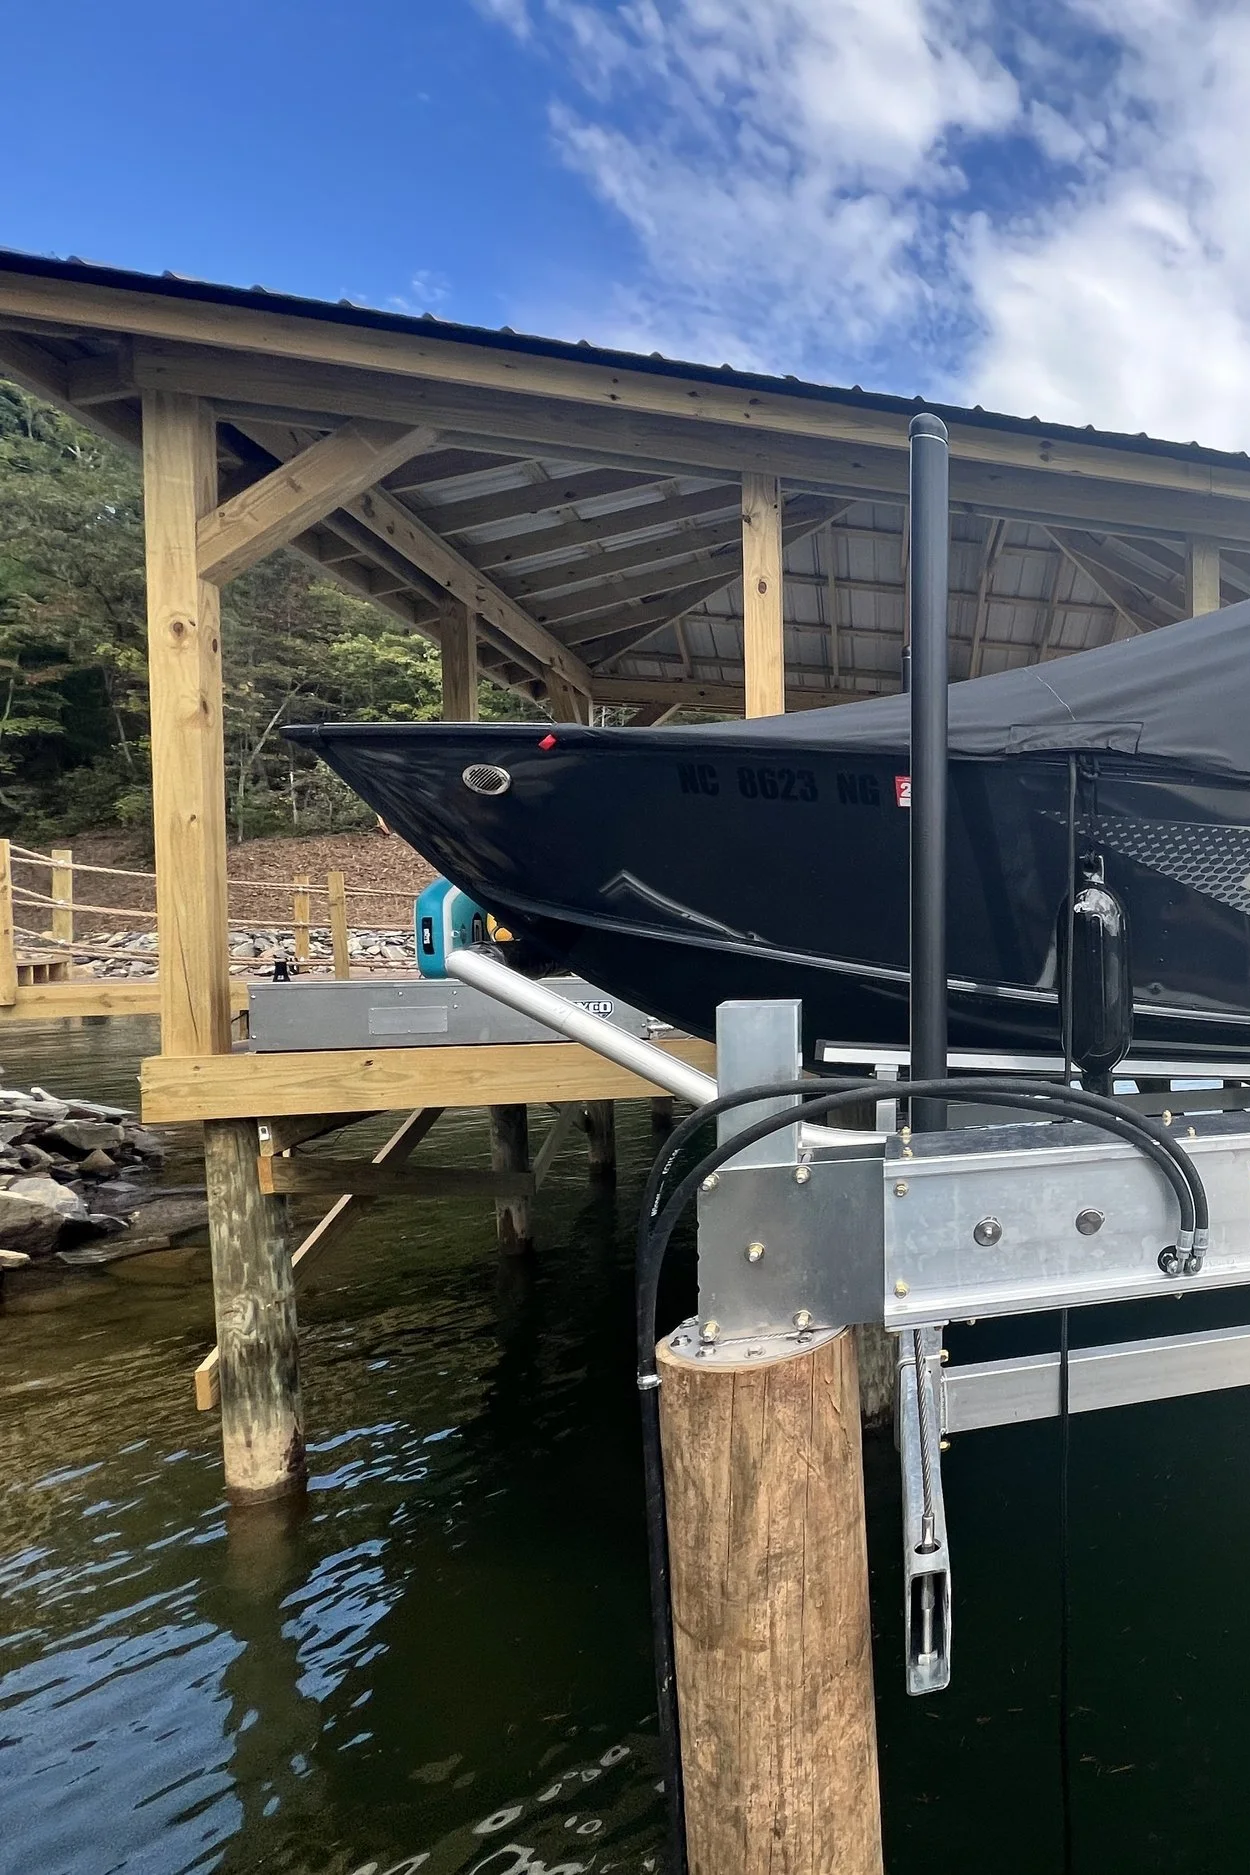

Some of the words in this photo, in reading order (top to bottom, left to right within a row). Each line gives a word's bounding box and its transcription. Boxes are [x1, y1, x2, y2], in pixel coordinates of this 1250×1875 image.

[676, 761, 720, 797] NC
[736, 766, 819, 803] 8623
[836, 770, 881, 807] NG
[573, 1002, 612, 1013] YCO
